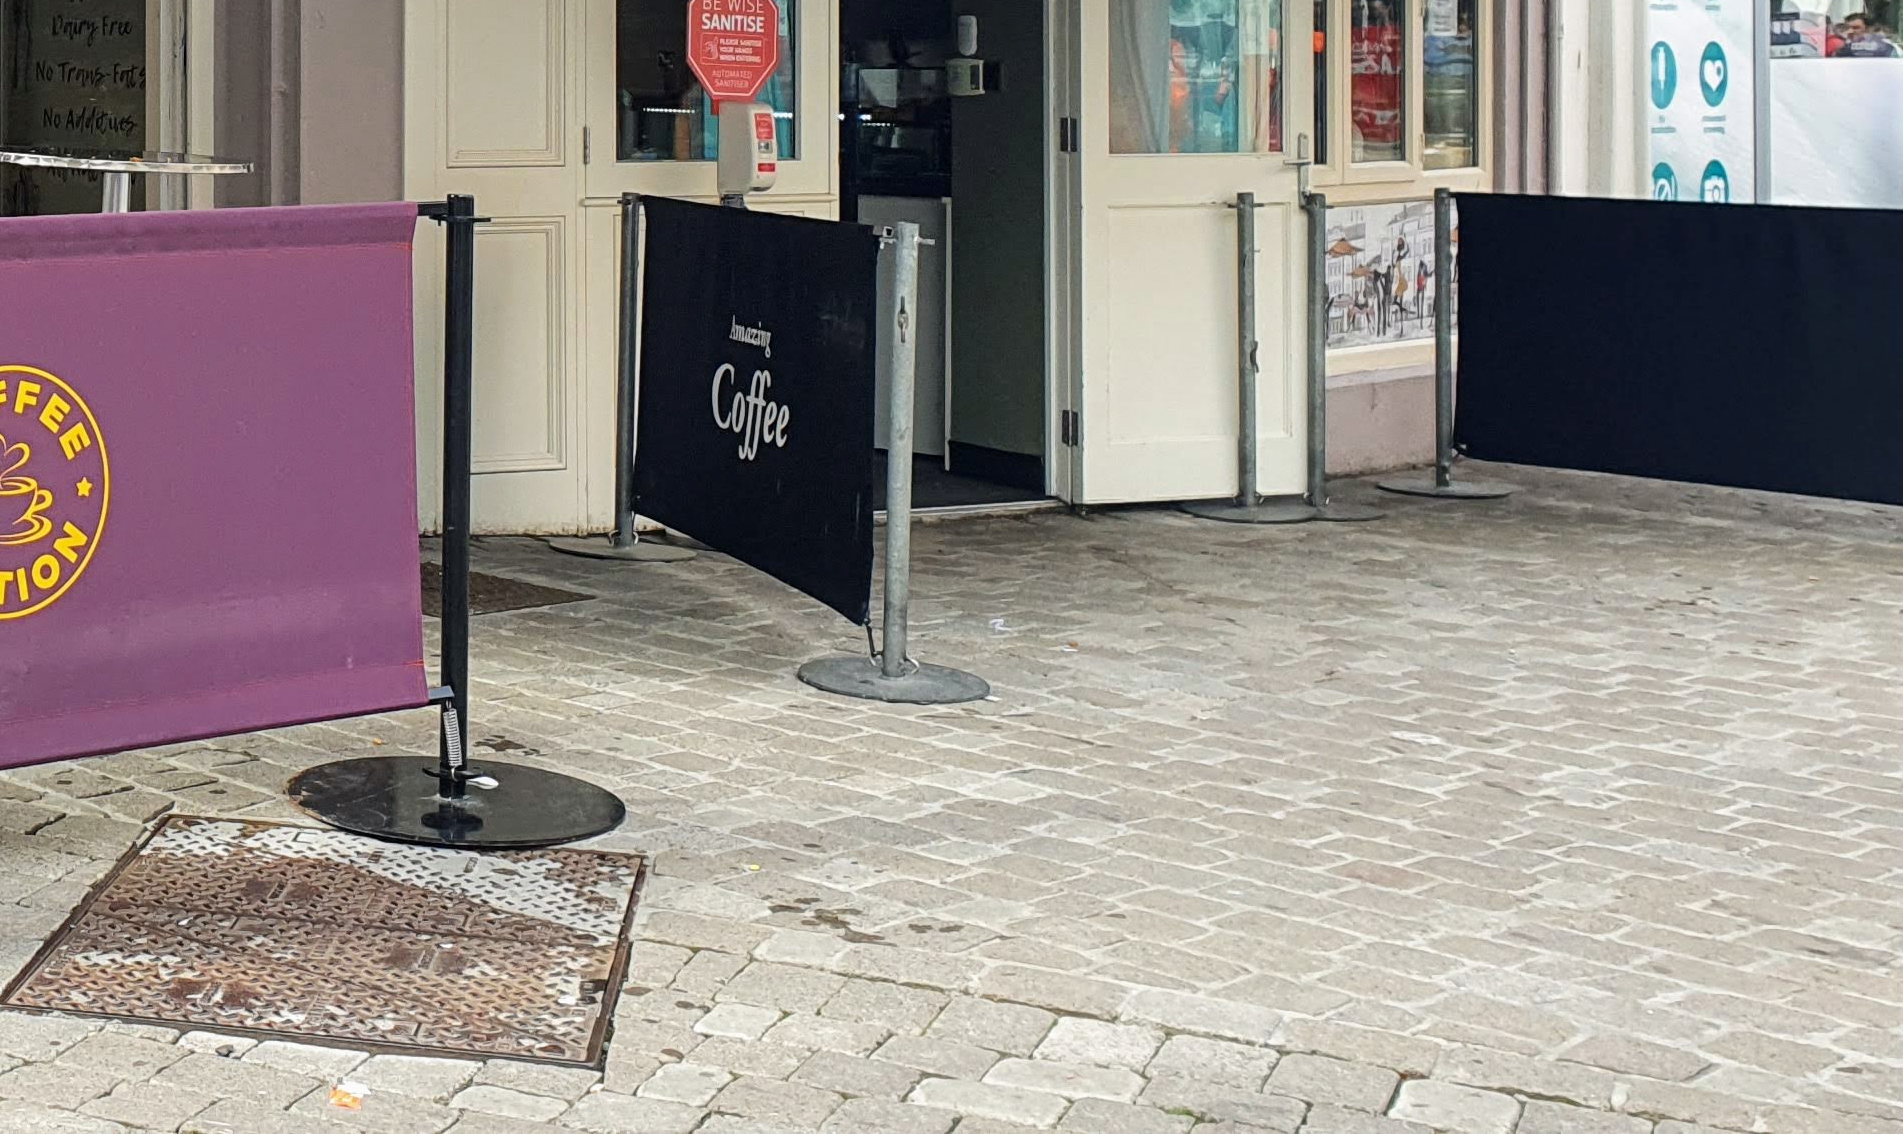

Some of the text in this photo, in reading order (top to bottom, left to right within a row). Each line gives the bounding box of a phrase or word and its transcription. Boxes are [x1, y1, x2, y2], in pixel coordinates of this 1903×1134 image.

[52, 15, 132, 47] Dairy Free
[702, 13, 764, 32] SANITISE
[36, 61, 53, 82] No
[43, 107, 61, 128] No
[730, 314, 772, 357] Amazing
[711, 363, 791, 461] Coffee
